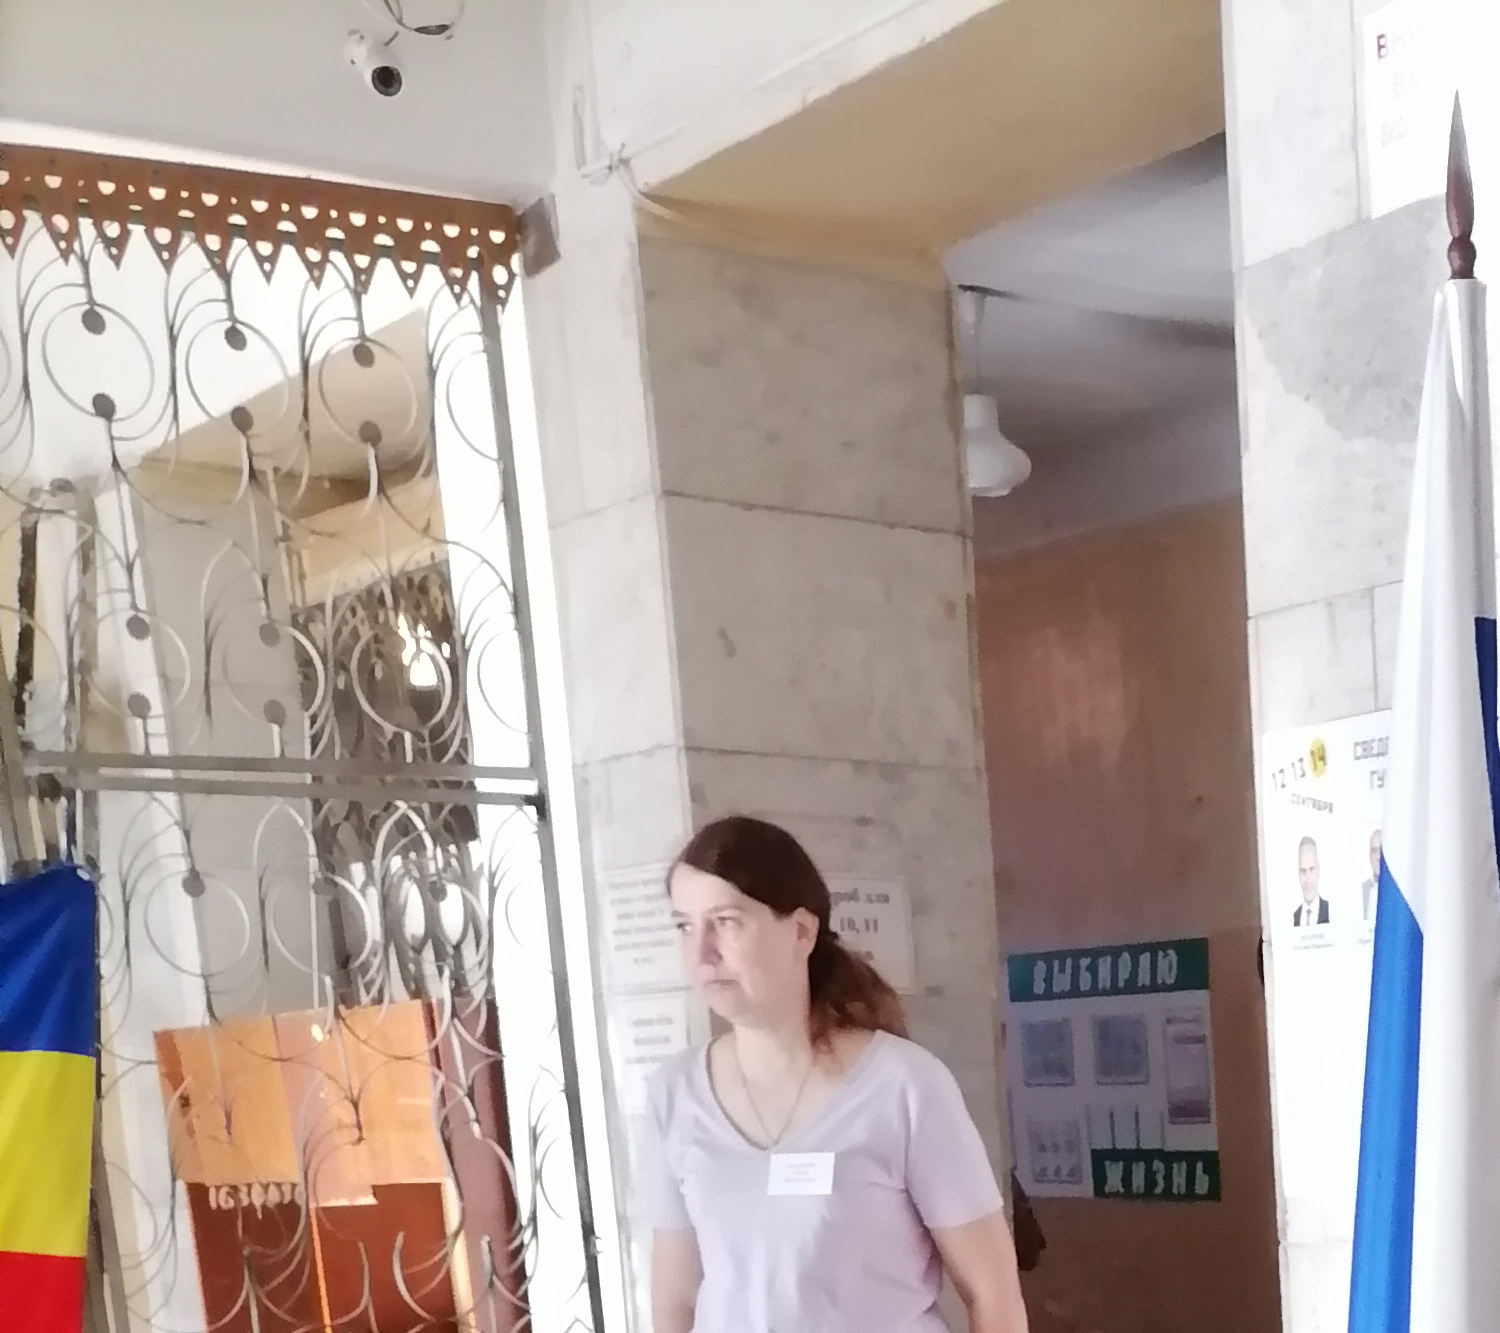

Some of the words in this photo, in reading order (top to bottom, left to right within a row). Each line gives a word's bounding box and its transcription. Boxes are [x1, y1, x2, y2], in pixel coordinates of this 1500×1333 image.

[1271, 768, 1287, 792] 12
[1310, 743, 1327, 772] 14
[1032, 949, 1179, 995] ВЫБИРАЮ
[1104, 1159, 1210, 1195] ЖИЗНЬ
